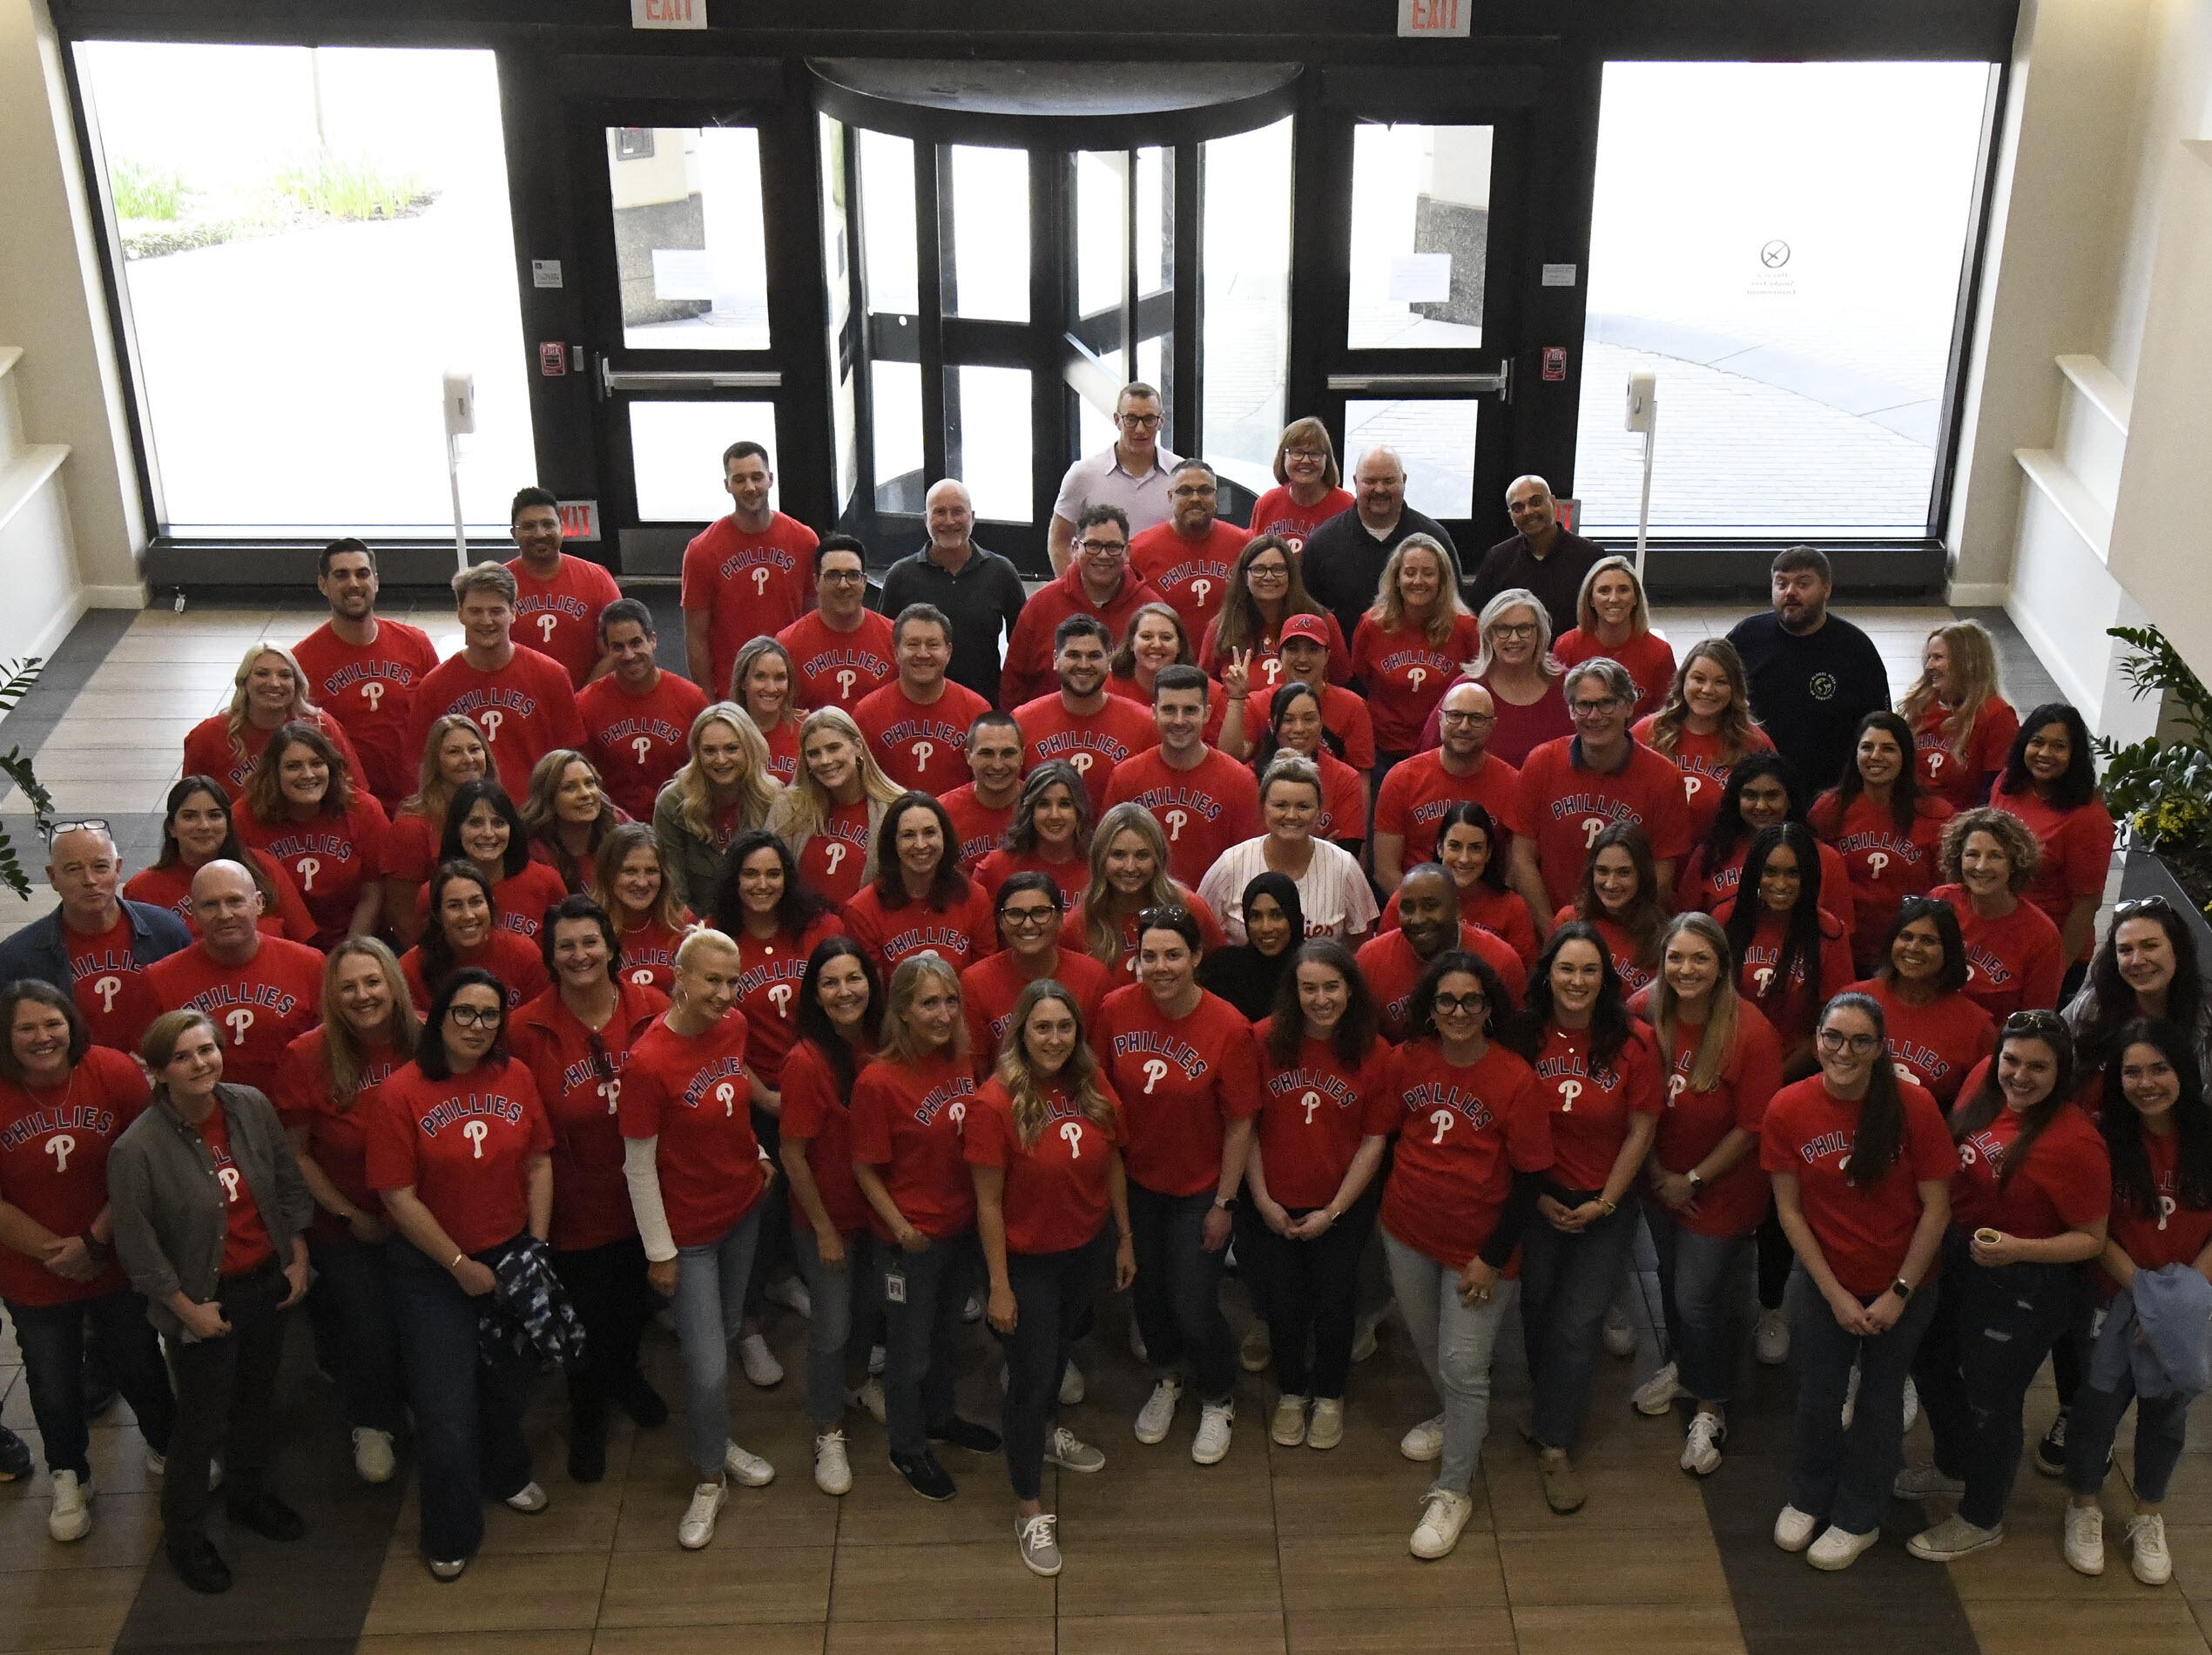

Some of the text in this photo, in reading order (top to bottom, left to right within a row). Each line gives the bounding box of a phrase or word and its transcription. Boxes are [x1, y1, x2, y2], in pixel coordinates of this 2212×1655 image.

[1413, 0, 1457, 29] EXIT
[560, 505, 590, 537] XIT
[720, 547, 795, 579] PHILLIES
[752, 567, 770, 596] P
[1190, 578, 1211, 607] P
[515, 594, 587, 619] HILLIES
[536, 613, 557, 642] P
[323, 660, 413, 696] PHILLIES
[803, 649, 889, 679] PHILLIES
[1262, 659, 1282, 685] P
[1381, 650, 1453, 676] PHILLIES
[1407, 667, 1426, 692] P
[361, 682, 384, 712] P
[836, 669, 857, 699] P
[481, 711, 502, 741] P
[601, 718, 681, 746] PHILLIES
[880, 719, 967, 750] PHILLIES
[632, 737, 651, 764] P
[912, 741, 934, 772] P
[1036, 730, 1130, 764] PHILLIES
[1927, 753, 1944, 778] P
[1165, 809, 1187, 841] P
[1581, 817, 1604, 848] P
[826, 842, 846, 875] P
[1839, 831, 1922, 865] PHILLIES
[297, 857, 320, 891] P
[1867, 852, 1889, 879] P
[884, 926, 969, 961] PHILLIES
[94, 976, 122, 1013] P
[768, 983, 792, 1017] P
[226, 1009, 254, 1045] P
[1114, 1031, 1208, 1079] PHILLIES
[683, 1057, 743, 1108] PHILLIE
[1143, 1059, 1167, 1094] P
[1268, 1068, 1357, 1107] PHILLIES
[1667, 1073, 1687, 1108] P
[597, 1078, 621, 1114] P
[716, 1083, 734, 1117] P
[914, 1077, 975, 1126] PHILLIE
[1300, 1091, 1320, 1125] P
[1557, 1079, 1582, 1111] P
[1, 1105, 114, 1152] PHILLIES
[419, 1093, 523, 1138] PHILLIES
[948, 1102, 966, 1136] P
[1430, 1109, 1454, 1144] P
[44, 1134, 75, 1172] P
[463, 1120, 488, 1158] P
[1060, 1122, 1082, 1158] P
